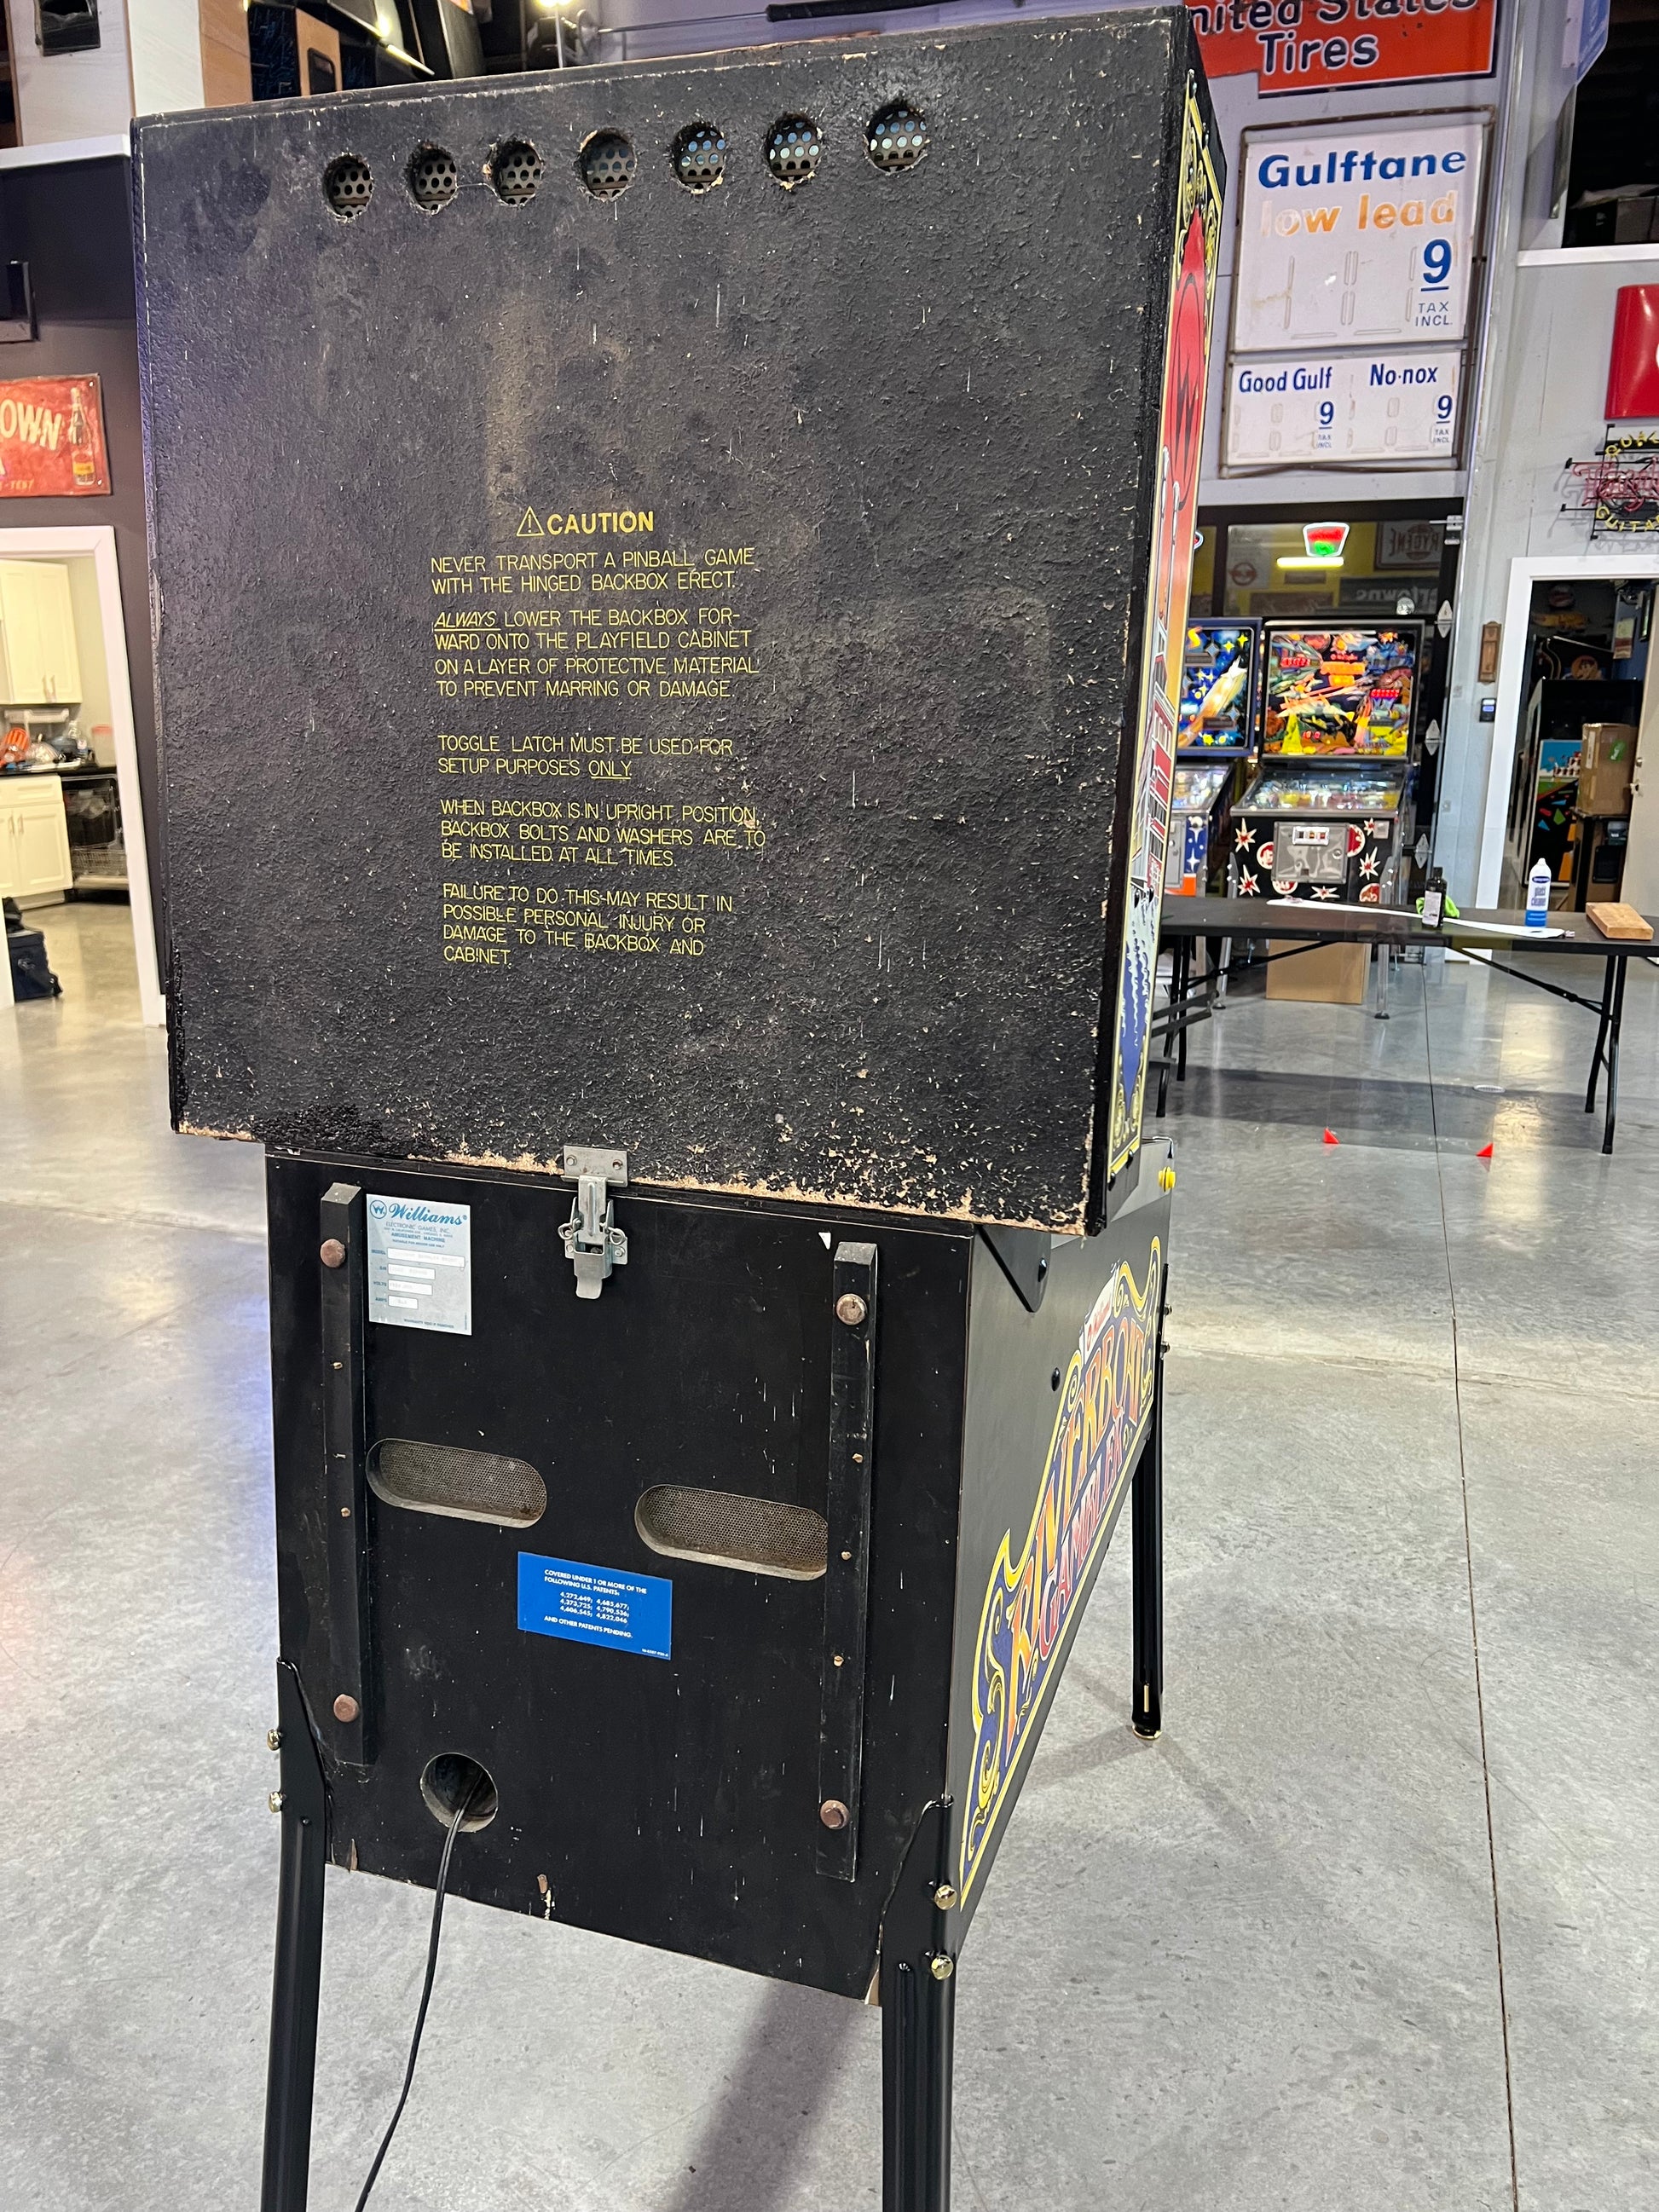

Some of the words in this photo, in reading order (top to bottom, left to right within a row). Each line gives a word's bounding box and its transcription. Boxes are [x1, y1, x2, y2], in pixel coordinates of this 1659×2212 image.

[1257, 32, 1379, 75] Tires
[1258, 150, 1466, 188] Gulftane
[1260, 200, 1343, 237] low
[1357, 190, 1458, 230] lead
[1423, 239, 1452, 284] 9
[1419, 302, 1449, 313] TAX
[1415, 315, 1453, 326] INCL.
[1239, 370, 1287, 393] Good
[1292, 367, 1332, 390] Gulf
[1320, 401, 1334, 425] 9
[1437, 394, 1453, 419] 9
[546, 511, 654, 535] CAUTION
[1596, 506, 1659, 532] GUITA
[431, 556, 486, 573] NEVER
[496, 552, 598, 571] TRANSPORT
[604, 552, 616, 568] A
[623, 551, 695, 568] PINBALL
[704, 548, 755, 566] GAME
[431, 578, 472, 594] WITH
[480, 577, 512, 593] THE
[521, 575, 581, 592] HINGED
[592, 573, 668, 591] BACKBOX
[678, 571, 736, 589] ERECT.
[433, 611, 500, 632] ALWAYS
[505, 610, 561, 627] LOWER
[569, 609, 602, 626] THE
[609, 609, 688, 626] BACKBOX
[698, 608, 740, 624] FOR-
[435, 633, 480, 650] WARD
[486, 633, 529, 650] ONTO
[535, 633, 569, 649] THE
[576, 632, 669, 649] PLAYFIELD
[678, 630, 752, 648] CABINET
[435, 659, 458, 674] ON
[463, 660, 474, 674] A
[477, 659, 530, 674] LAYER
[537, 658, 558, 673] OF
[566, 657, 667, 673] PROTECTIVE
[673, 657, 759, 673] MATERIAL
[436, 681, 457, 697] TO
[465, 681, 539, 697] PREVENT
[546, 681, 618, 696] MARRING
[627, 681, 650, 696] OR
[660, 680, 735, 697] DAMAGE.
[438, 736, 500, 753] TOGGLE
[512, 736, 564, 753] LATCH
[570, 736, 616, 754] MUST
[621, 737, 643, 754] BE
[650, 739, 693, 755] USED
[699, 740, 733, 755] FOR
[438, 759, 489, 774] SETUP
[496, 759, 580, 776] PURPOSES
[588, 760, 632, 779] ONLY.
[441, 800, 485, 816] WHEN
[492, 800, 562, 818] BACKBOX
[568, 802, 580, 818] IS
[585, 803, 598, 818] IN
[606, 804, 674, 820] UPRIGHT
[442, 822, 510, 839] BACKBOX
[519, 824, 569, 841] BOLTS
[576, 826, 610, 843] AND
[616, 828, 693, 846] WASHERS
[702, 829, 737, 846] ARE
[743, 830, 766, 846] TO
[442, 843, 463, 859] BE
[471, 843, 552, 862] INSTALLED
[559, 846, 579, 863] AT
[586, 848, 618, 865] ALL
[443, 884, 506, 902] FAILURE
[509, 887, 529, 903] TO
[537, 887, 558, 904] DO
[565, 888, 600, 906] THIS
[606, 890, 641, 906] MAY
[646, 892, 708, 911] RESULT
[716, 895, 733, 912] IN
[443, 905, 517, 923] POSSIBLE
[524, 909, 609, 929] PERSONAL
[618, 914, 675, 933] INJURY
[682, 918, 705, 934] OR
[443, 925, 507, 944] DAMAGE
[515, 929, 536, 945] TO
[545, 930, 575, 947] THE
[585, 933, 662, 953] BACKBOX
[669, 939, 704, 956] AND
[389, 1203, 462, 1225] Williams
[1005, 1317, 1145, 1767] RIVERBOAT
[1039, 1405, 1125, 1661] GAMBLER
[545, 1569, 571, 1579] COVERED
[572, 1574, 592, 1583] UNDER
[607, 1581, 625, 1590] MORE
[545, 1576, 580, 1588] FOLLOWING
[558, 1618, 577, 1627] OTHER
[578, 1622, 603, 1632] PATENTS
[603, 1627, 633, 1638] PENDING.
